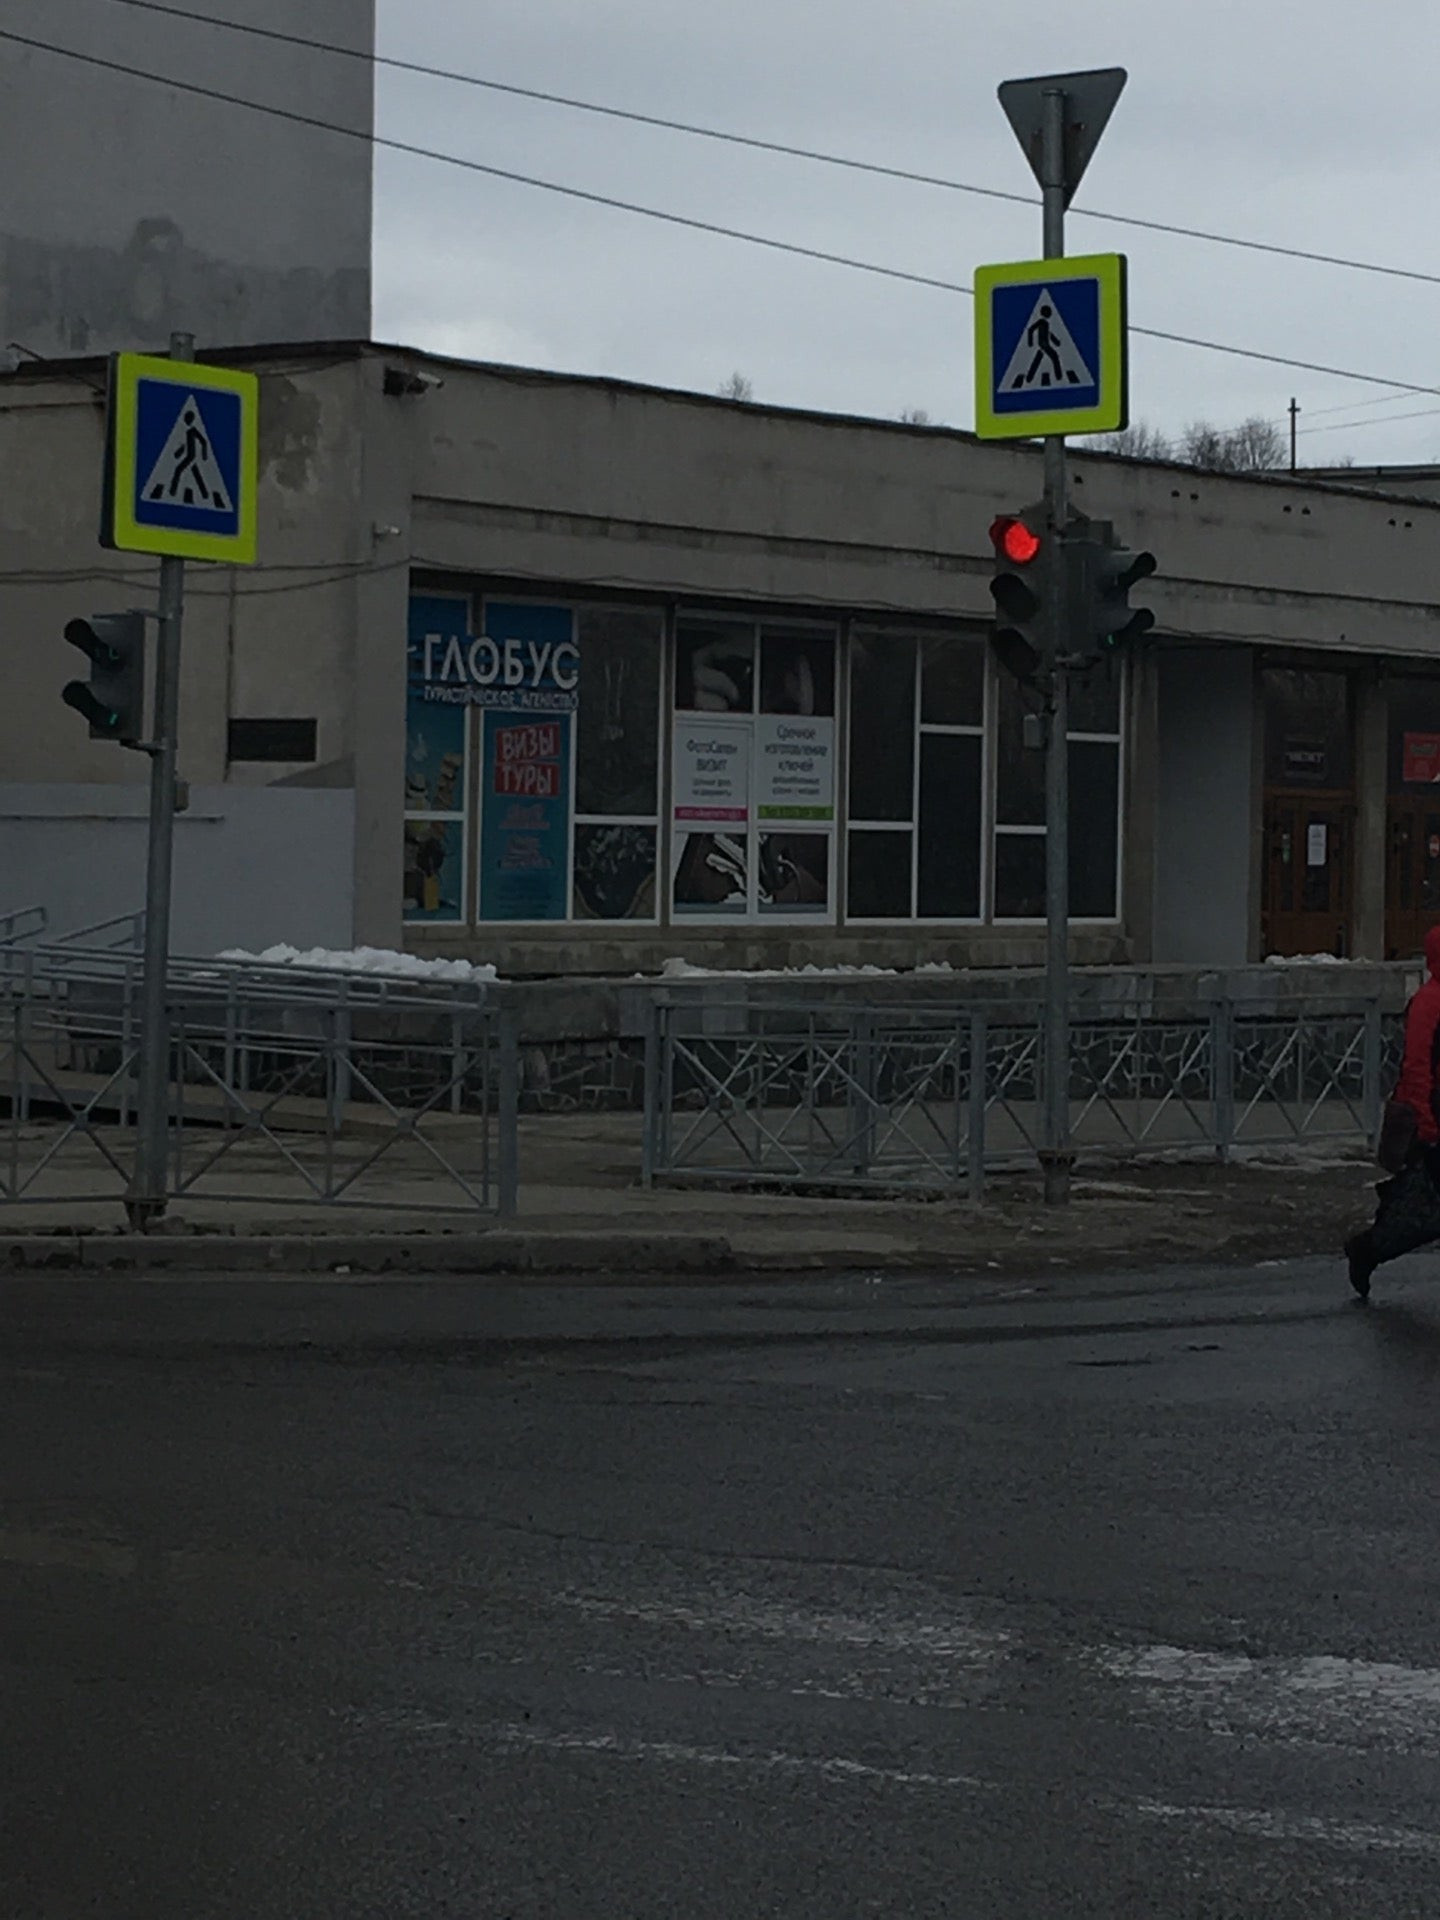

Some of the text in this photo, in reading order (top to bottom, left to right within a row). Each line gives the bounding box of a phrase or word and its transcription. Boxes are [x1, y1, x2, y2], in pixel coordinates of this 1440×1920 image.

[423, 633, 580, 690] ГЛОБУС
[501, 727, 555, 760] ВИЗЫ
[502, 764, 552, 794] ТУРЫ
